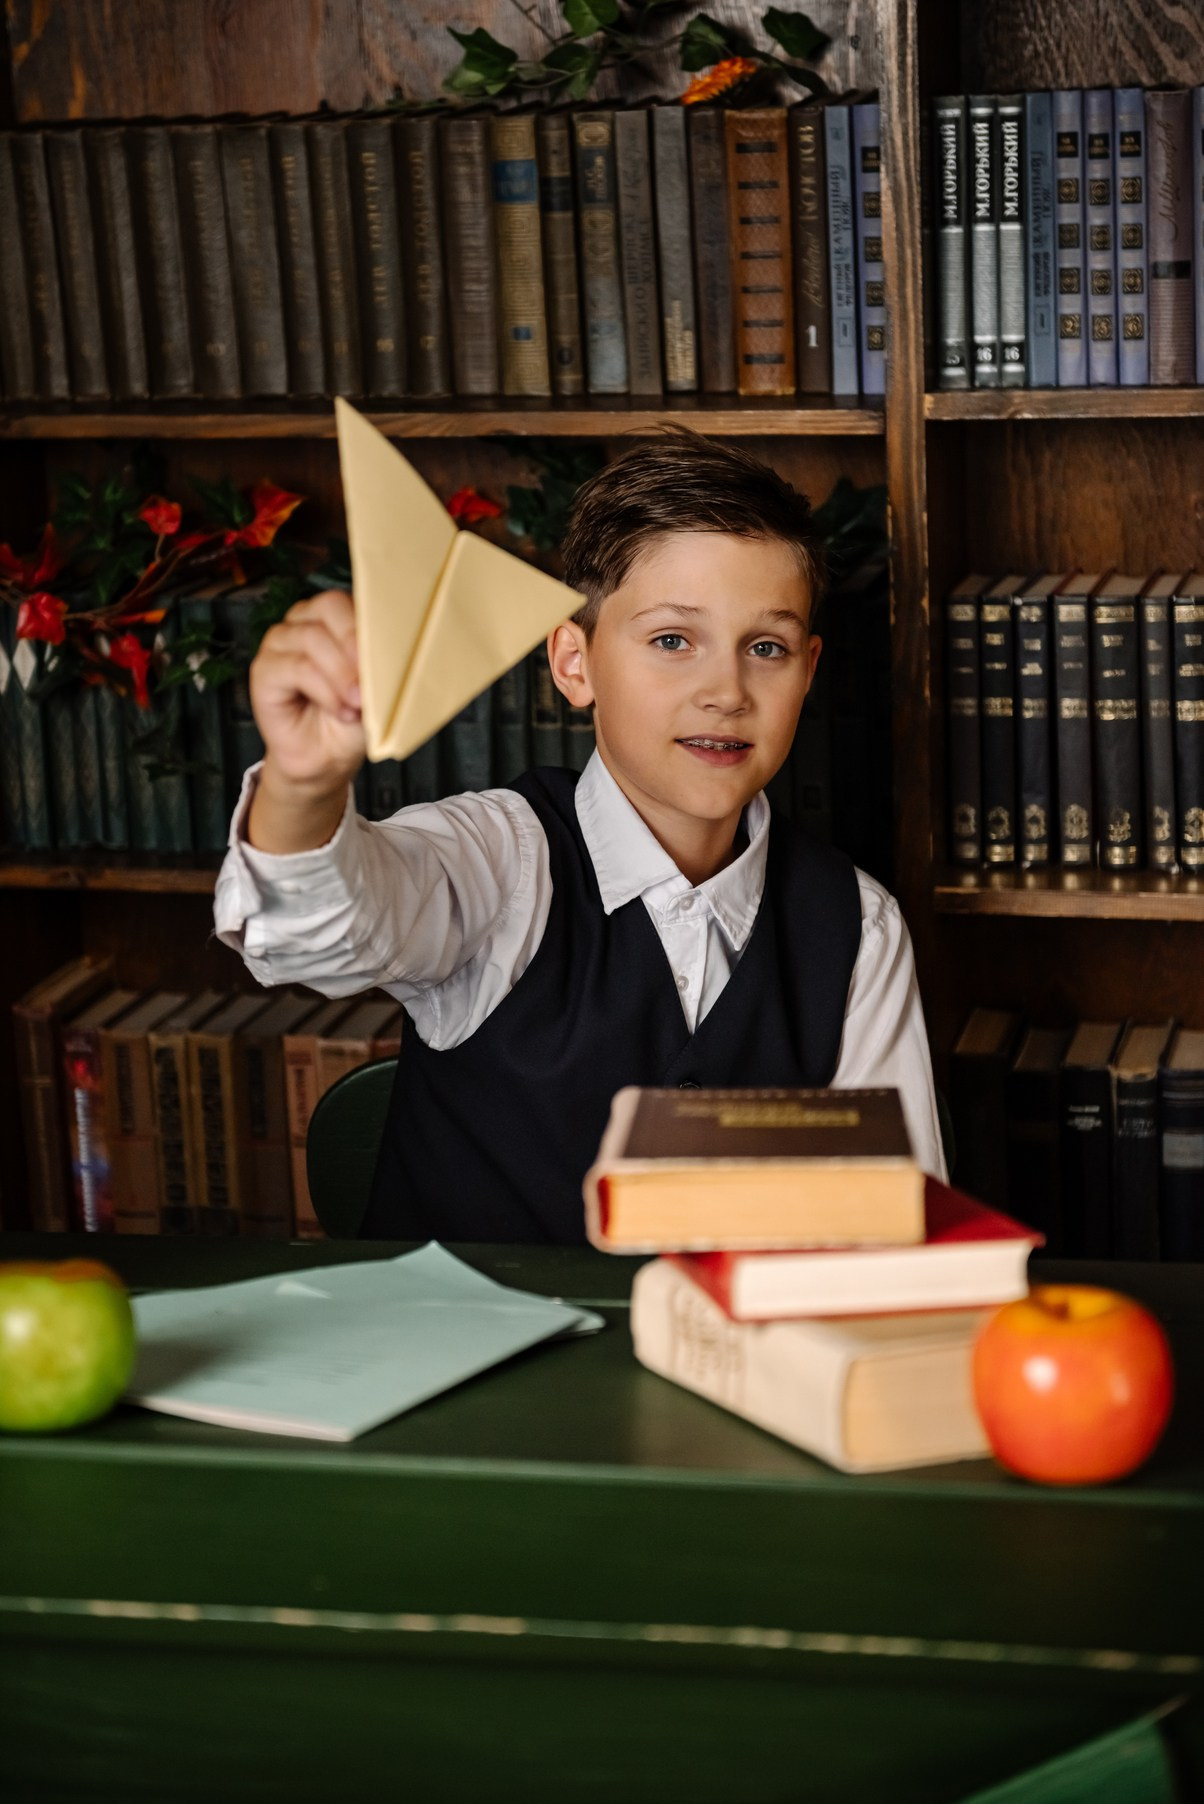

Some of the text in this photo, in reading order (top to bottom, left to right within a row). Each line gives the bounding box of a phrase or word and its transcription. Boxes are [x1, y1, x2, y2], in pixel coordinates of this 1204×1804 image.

[940, 123, 958, 219] М.ГОРЬКИЙ
[972, 122, 990, 217] М.ГОРЬКИЙ
[1002, 121, 1019, 216] М.ГОРЬКИЙ
